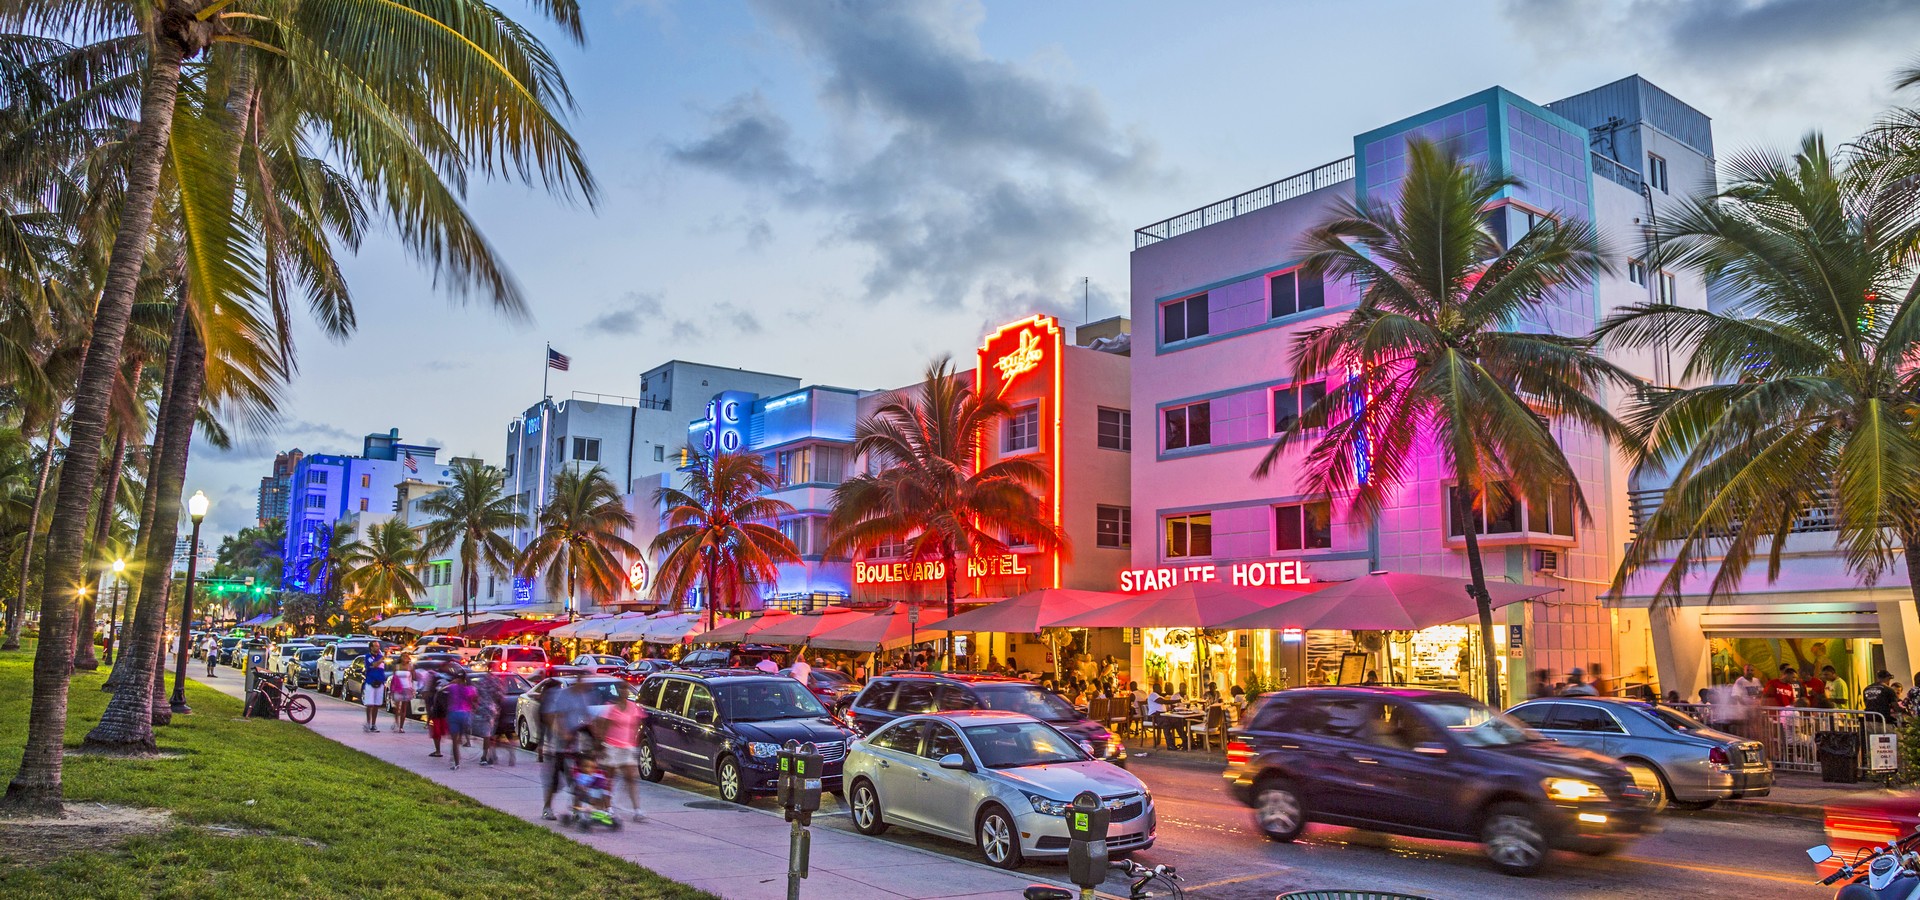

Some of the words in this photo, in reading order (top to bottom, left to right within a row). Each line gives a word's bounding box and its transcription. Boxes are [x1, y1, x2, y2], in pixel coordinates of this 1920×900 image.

[856, 561, 945, 583] BOULEVARD
[967, 554, 1027, 577] HOTEL
[1232, 561, 1311, 586] HOTEL
